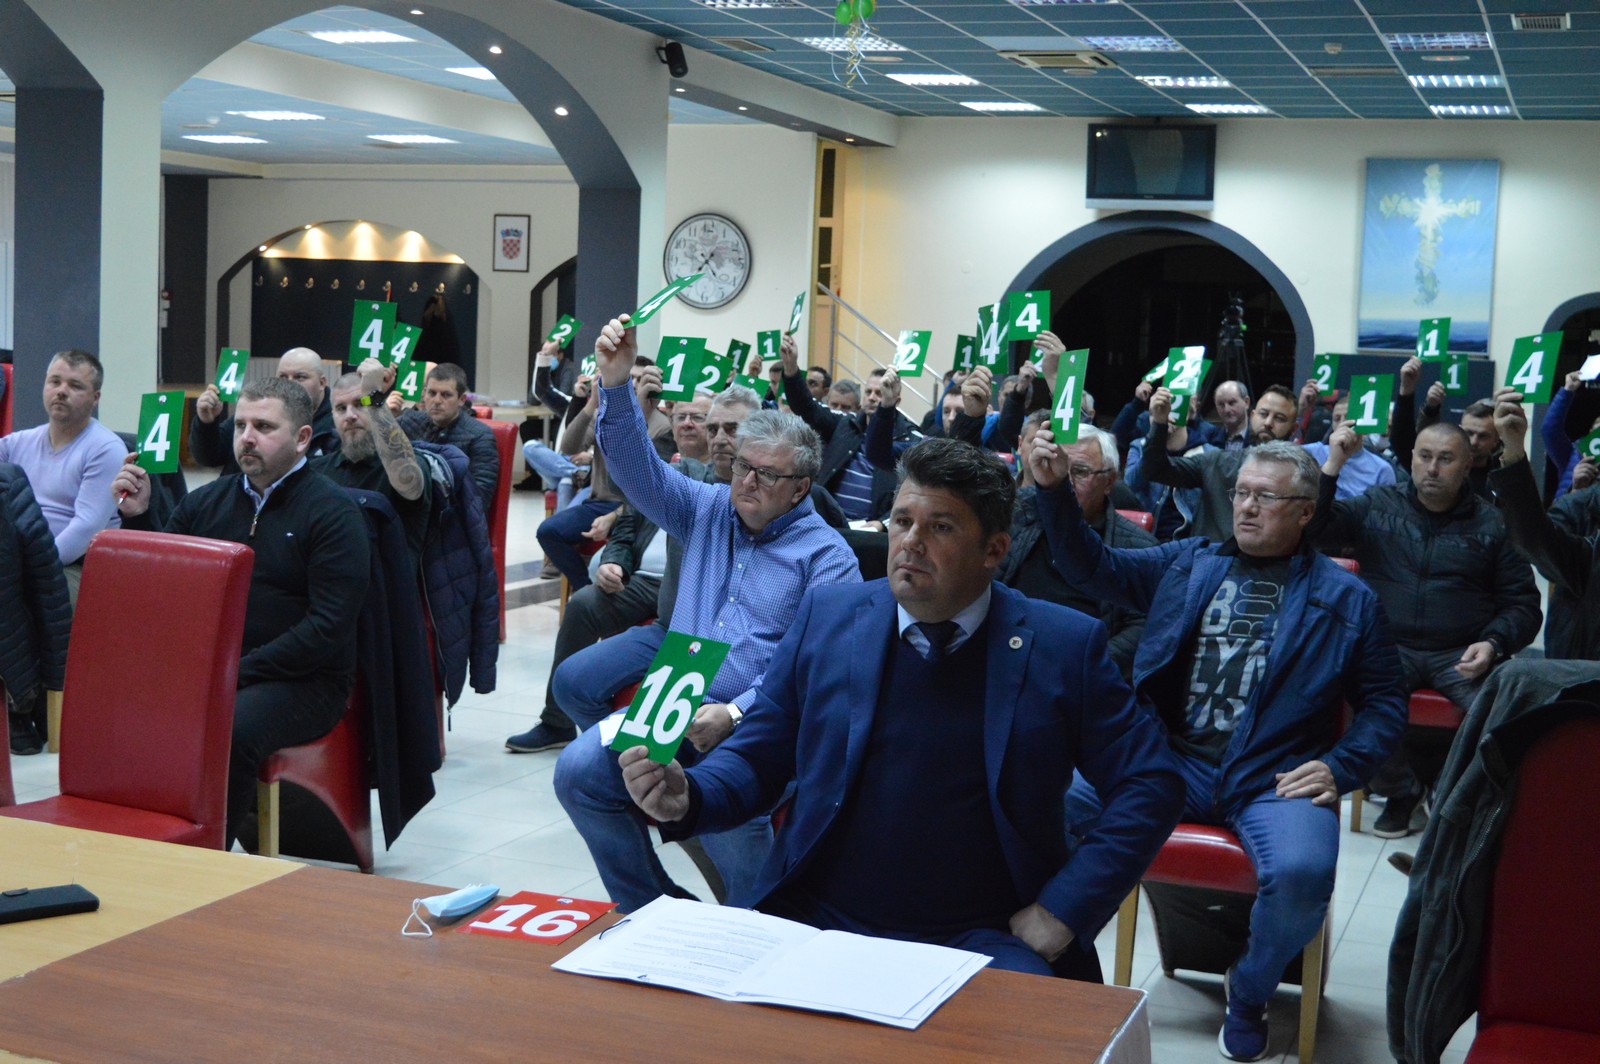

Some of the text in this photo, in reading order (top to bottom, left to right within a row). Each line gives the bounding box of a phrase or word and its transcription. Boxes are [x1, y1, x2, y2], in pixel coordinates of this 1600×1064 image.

[639, 286, 680, 318] 4
[1015, 302, 1042, 332] 4
[359, 319, 384, 358] 4
[552, 323, 573, 343] 2
[763, 338, 777, 358] 1
[979, 321, 1000, 365] 4
[1423, 329, 1440, 356] 1
[390, 336, 409, 363] 4
[731, 349, 743, 369] 1
[898, 342, 921, 371] 2
[960, 345, 973, 368] 1
[219, 362, 239, 395] 4
[400, 371, 418, 397] 4
[661, 353, 686, 392] 1
[694, 365, 720, 395] 2
[1168, 360, 1191, 389] 2
[1316, 364, 1332, 391] 2
[1446, 364, 1461, 389] 1
[1512, 351, 1545, 394] 4
[1054, 375, 1076, 431] 4
[1355, 390, 1378, 426] 1
[143, 413, 170, 462] 4
[620, 664, 706, 745] 16
[469, 903, 591, 938] 16
